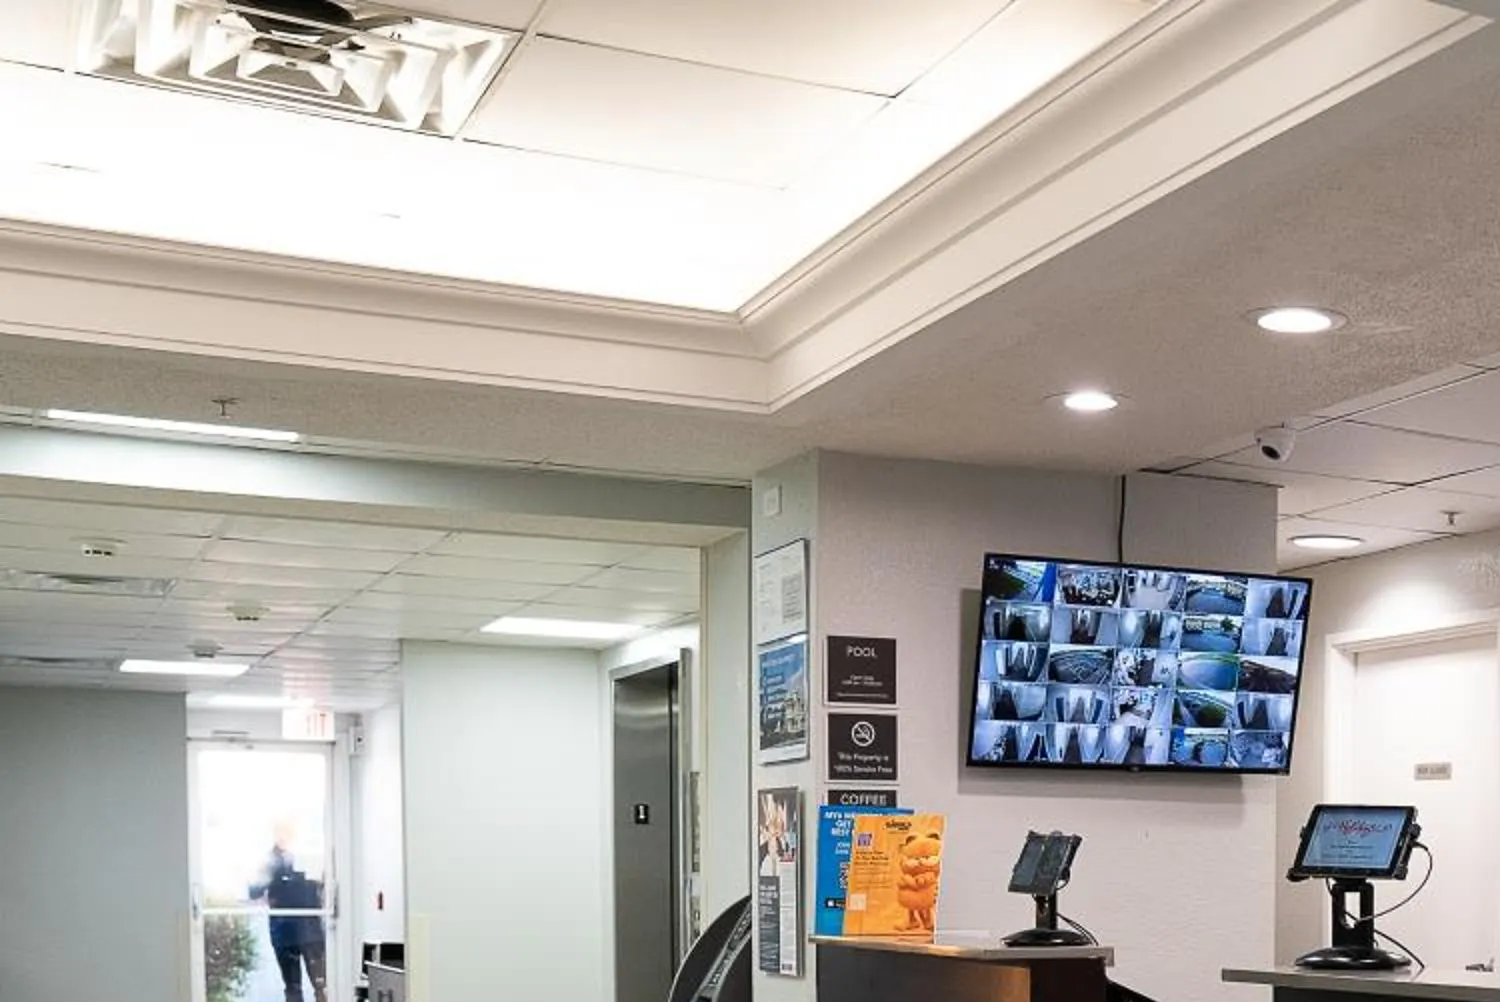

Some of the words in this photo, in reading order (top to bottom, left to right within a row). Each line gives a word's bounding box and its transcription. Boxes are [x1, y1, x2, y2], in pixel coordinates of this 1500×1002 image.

[846, 645, 878, 659] POOL
[853, 752, 881, 763] Property
[853, 764, 877, 773] Smoke
[877, 765, 893, 774] Free
[840, 792, 888, 805] COFFEE
